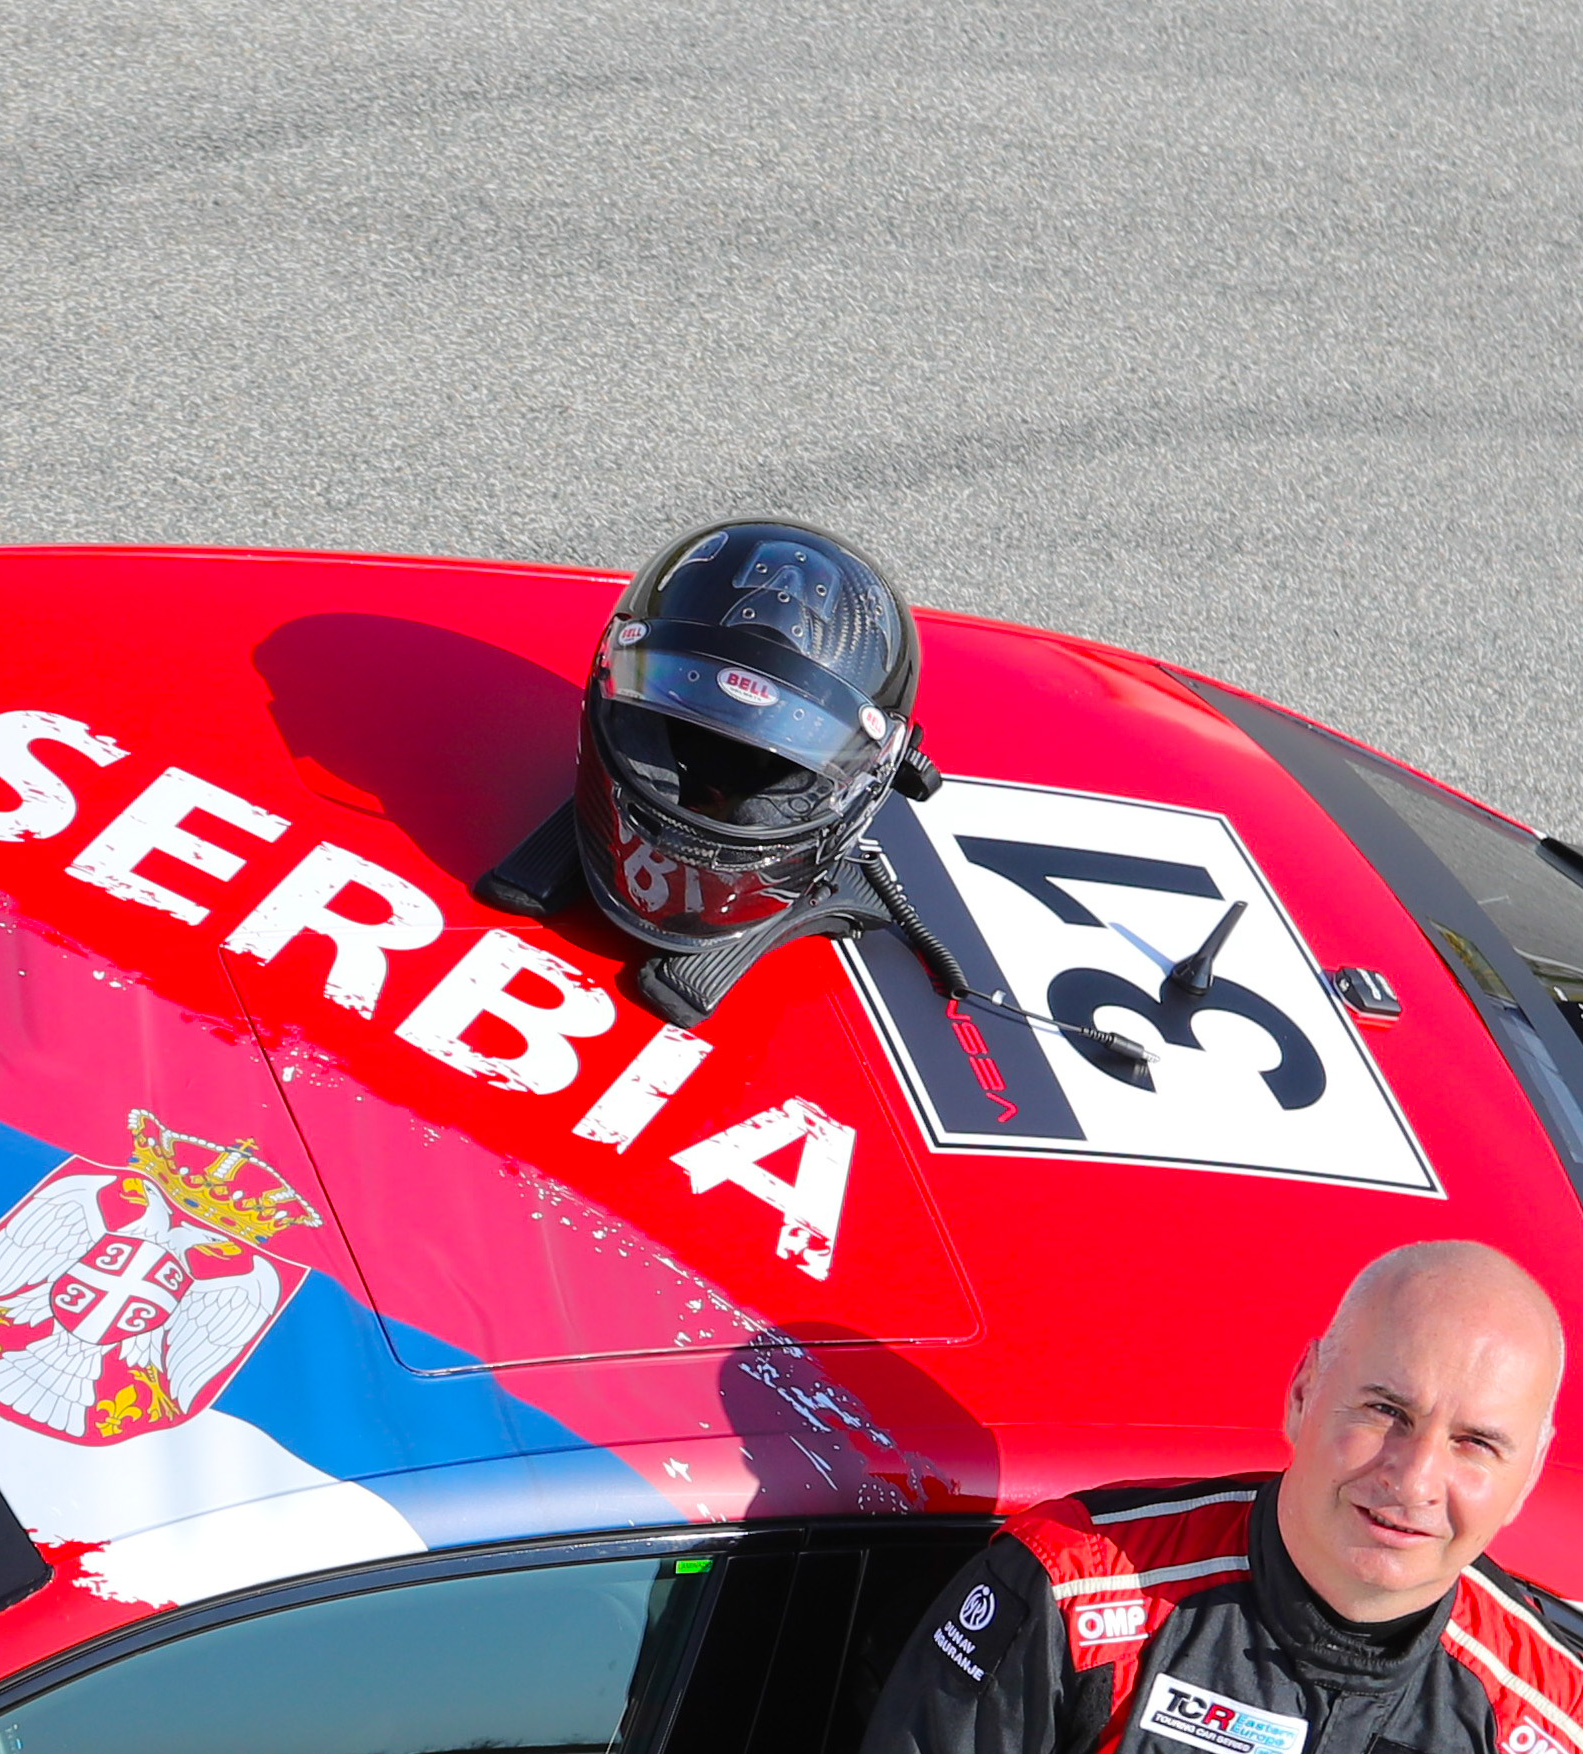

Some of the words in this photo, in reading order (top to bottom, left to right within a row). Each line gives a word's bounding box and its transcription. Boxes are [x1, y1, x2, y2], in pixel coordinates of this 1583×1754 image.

[726, 672, 770, 699] BELL
[953, 834, 1327, 1111] 31
[1078, 1605, 1146, 1640] OMP
[1155, 1713, 1196, 1733] TOURING
[1196, 1726, 1216, 1741] CAR
[1168, 1686, 1236, 1731] TCR
[1237, 1713, 1297, 1739] Eastern
[1231, 1724, 1285, 1748] Europe
